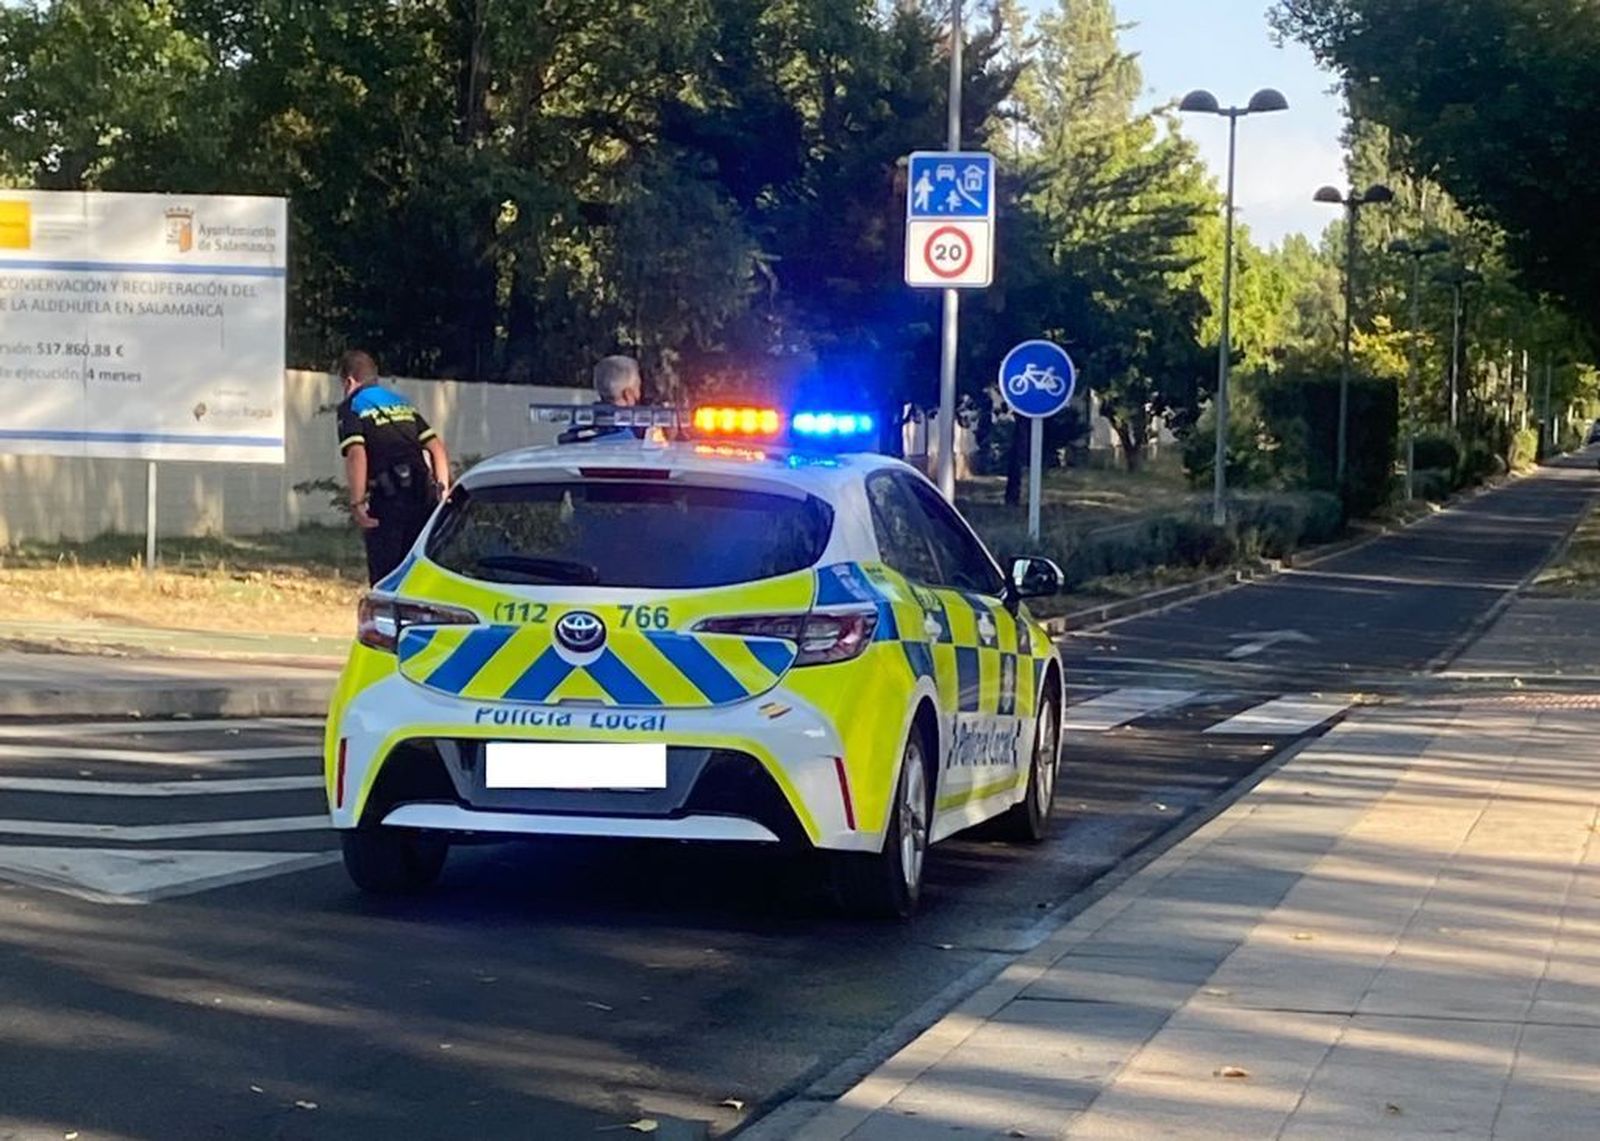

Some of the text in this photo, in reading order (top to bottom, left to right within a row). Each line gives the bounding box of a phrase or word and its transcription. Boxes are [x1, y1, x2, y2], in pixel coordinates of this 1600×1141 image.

[199, 223, 276, 238] Ayuntamiento
[215, 239, 275, 252] Salamanca
[936, 245, 961, 261] 20
[110, 280, 118, 291] Y
[232, 284, 257, 297] DEL
[11, 299, 27, 312] LA
[31, 299, 111, 313] ALDEHUELA
[115, 302, 133, 315] EN
[137, 303, 224, 317] SALAMANCA
[87, 368, 95, 379] 4
[99, 371, 141, 381] meses
[617, 604, 669, 629] 766
[589, 711, 666, 731] Local
